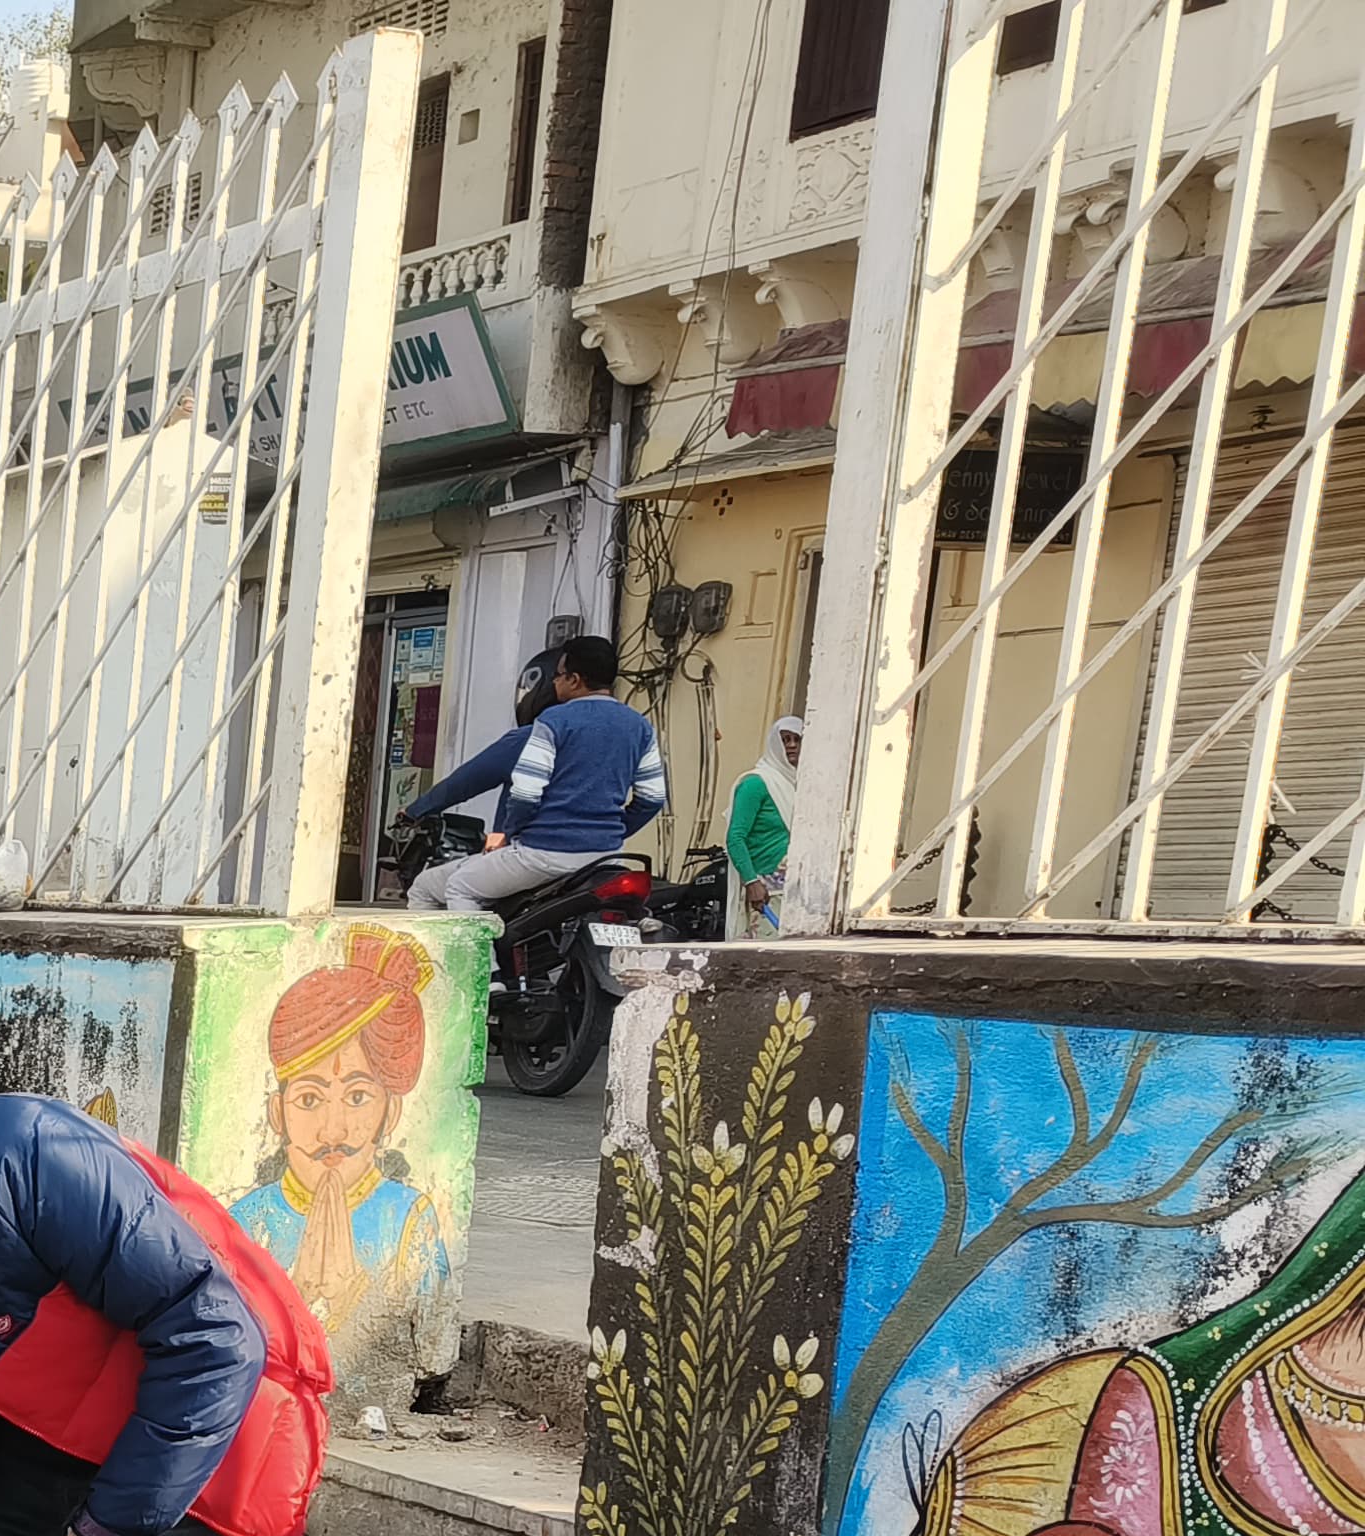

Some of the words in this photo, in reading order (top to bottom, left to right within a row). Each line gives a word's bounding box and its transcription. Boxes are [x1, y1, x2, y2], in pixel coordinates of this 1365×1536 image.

[389, 331, 452, 390] IUM
[402, 400, 434, 421] ETC.
[943, 497, 962, 521] &
